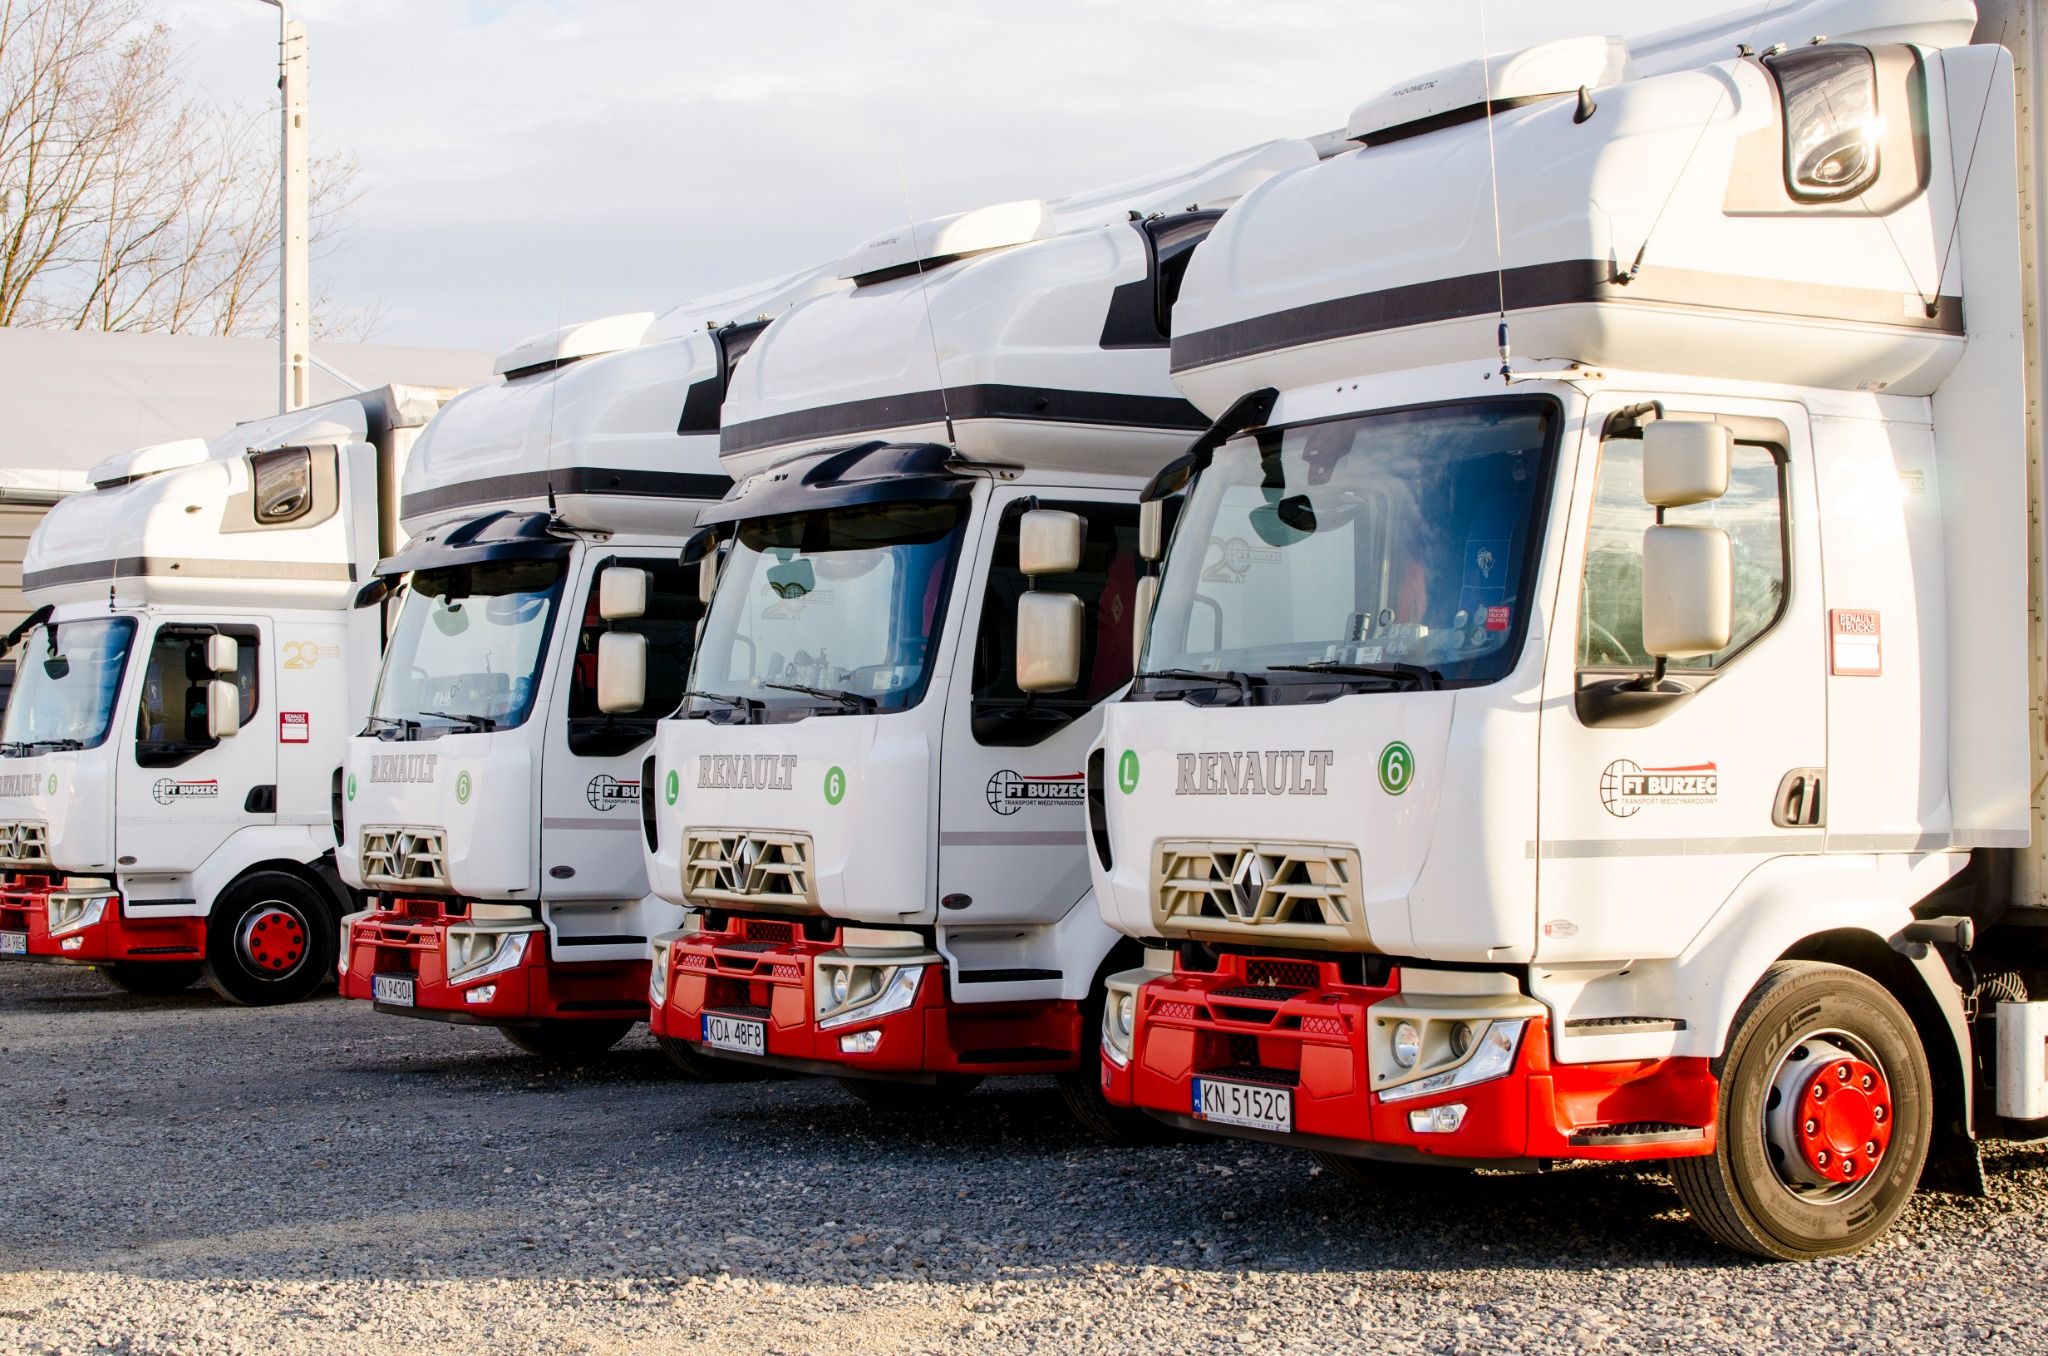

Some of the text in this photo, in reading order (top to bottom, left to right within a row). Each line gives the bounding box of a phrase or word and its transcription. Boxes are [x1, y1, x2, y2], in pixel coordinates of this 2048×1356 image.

[1228, 574, 1246, 584] LAT
[1839, 614, 1874, 624] RENAULT
[1841, 623, 1875, 633] TRUCKS
[370, 754, 437, 783] RENAULT
[697, 755, 797, 790] RENAULT
[1175, 750, 1333, 795] RENAULT
[1387, 751, 1403, 785] 6
[165, 785, 217, 795] FT BURZEC
[603, 786, 619, 797] FT
[829, 773, 840, 797] 6
[1006, 783, 1085, 798] FT BURZEC
[1623, 776, 1716, 794] FT BURZEC
[1037, 799, 1085, 807] MIĘDZYNARODOW
[377, 978, 387, 997] KN
[388, 980, 413, 1000] 9430A
[709, 1018, 762, 1047] KDA 48F8
[1194, 1098, 1201, 1108] PL
[1203, 1083, 1286, 1122] KN 5152C
